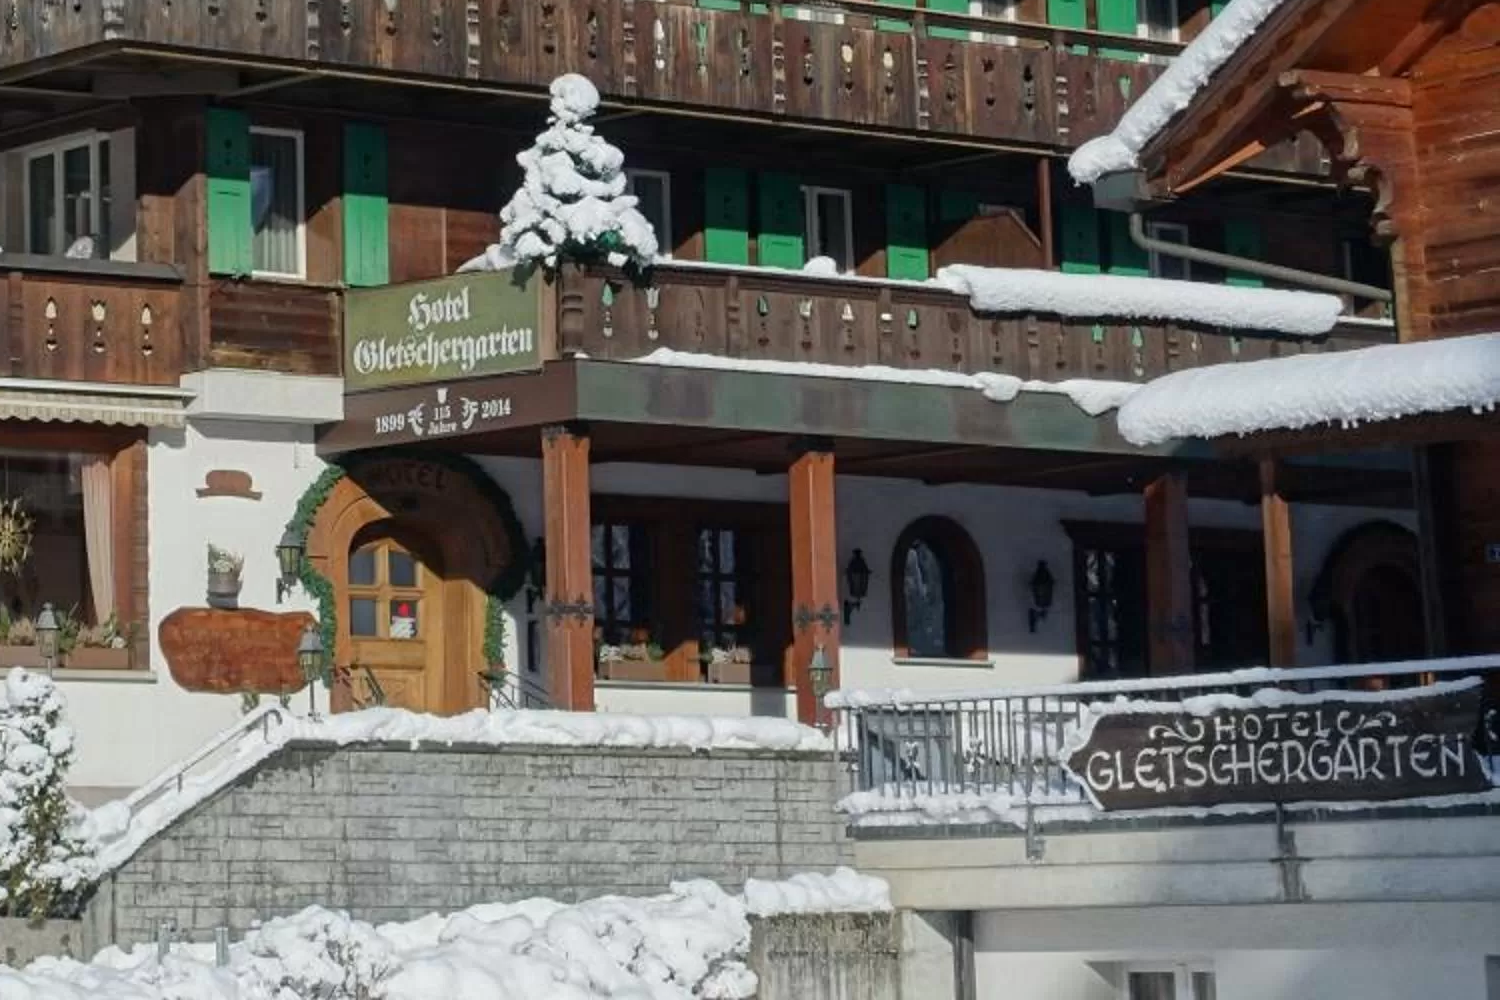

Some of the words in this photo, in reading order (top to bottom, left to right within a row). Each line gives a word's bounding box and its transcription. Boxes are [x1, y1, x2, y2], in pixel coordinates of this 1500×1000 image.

[407, 286, 471, 330] Hotel
[353, 324, 533, 376] Gletschergarten
[375, 413, 405, 434] 1899
[481, 398, 511, 419] 2014
[1214, 710, 1336, 742] HOTEL
[1086, 733, 1466, 792] GLETSCHERGARTEN
